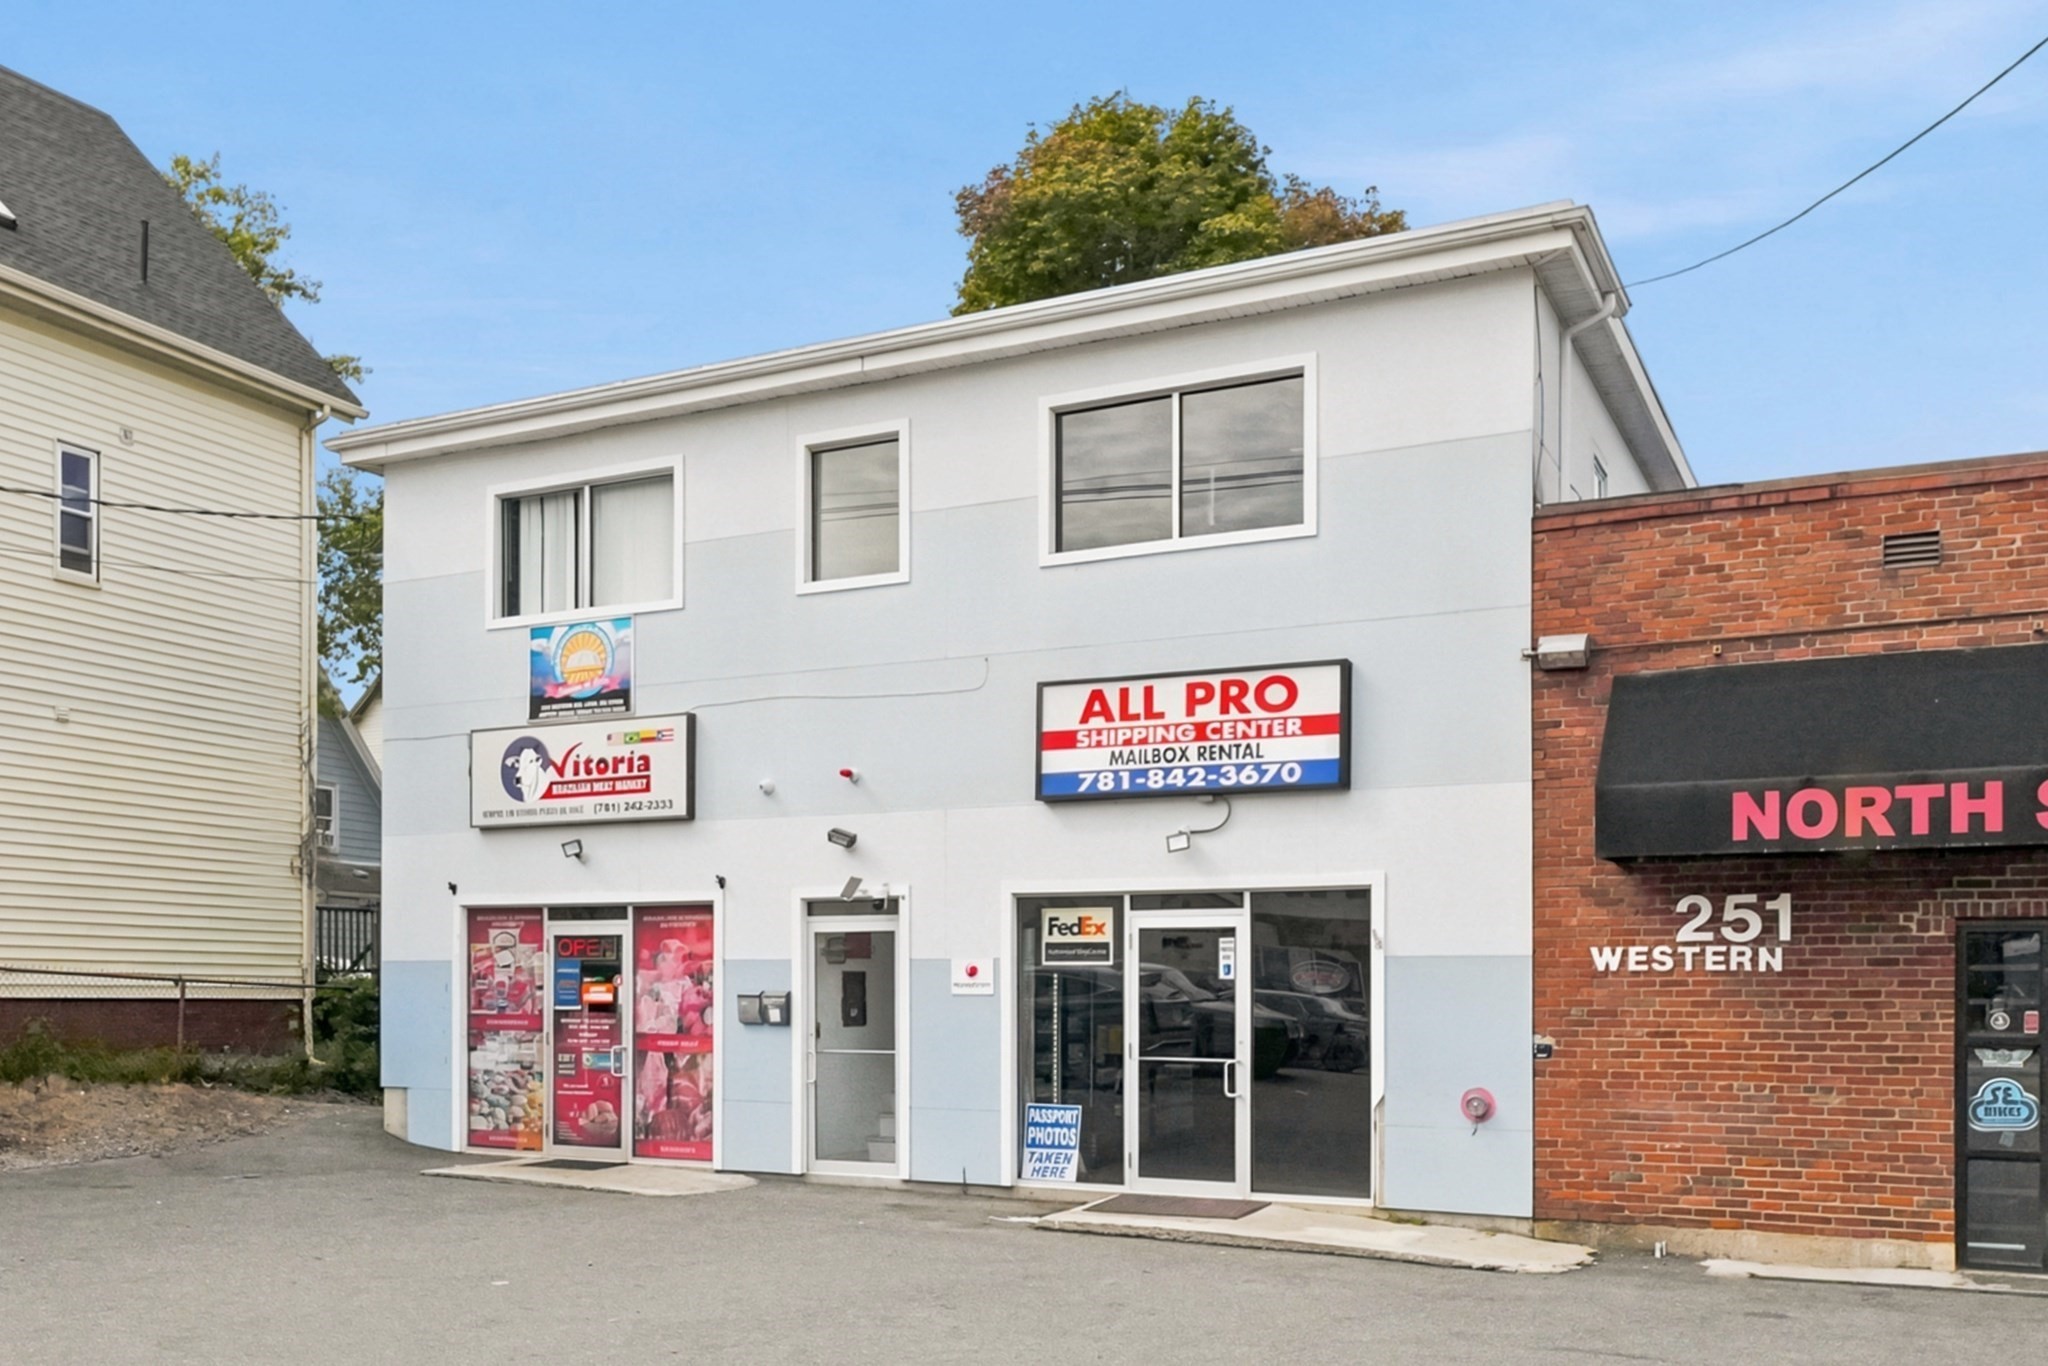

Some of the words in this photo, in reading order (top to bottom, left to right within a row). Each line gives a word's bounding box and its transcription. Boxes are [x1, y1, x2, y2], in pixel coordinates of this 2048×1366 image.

[1079, 685, 1165, 724] ALL
[1185, 675, 1298, 717] PRO
[1076, 723, 1196, 748] SHIPPING
[1206, 718, 1302, 740] CENTER
[550, 742, 650, 778] Vitoria
[1109, 746, 1190, 766] MAILBOX
[1197, 743, 1264, 762] RENTAL
[1078, 763, 1302, 792] 781-842-3670
[594, 802, 620, 814] (781)
[1732, 780, 2003, 842] NORTH
[1048, 916, 1106, 936] FedEx
[1675, 893, 1792, 943] 251
[558, 938, 614, 957] OPEN
[1589, 945, 1783, 973] WESTERN
[1028, 1108, 1079, 1124] PASSPORT
[1027, 1126, 1077, 1147] PHOTOS
[1028, 1151, 1074, 1165] TAKEN
[1030, 1166, 1069, 1179] HERE
